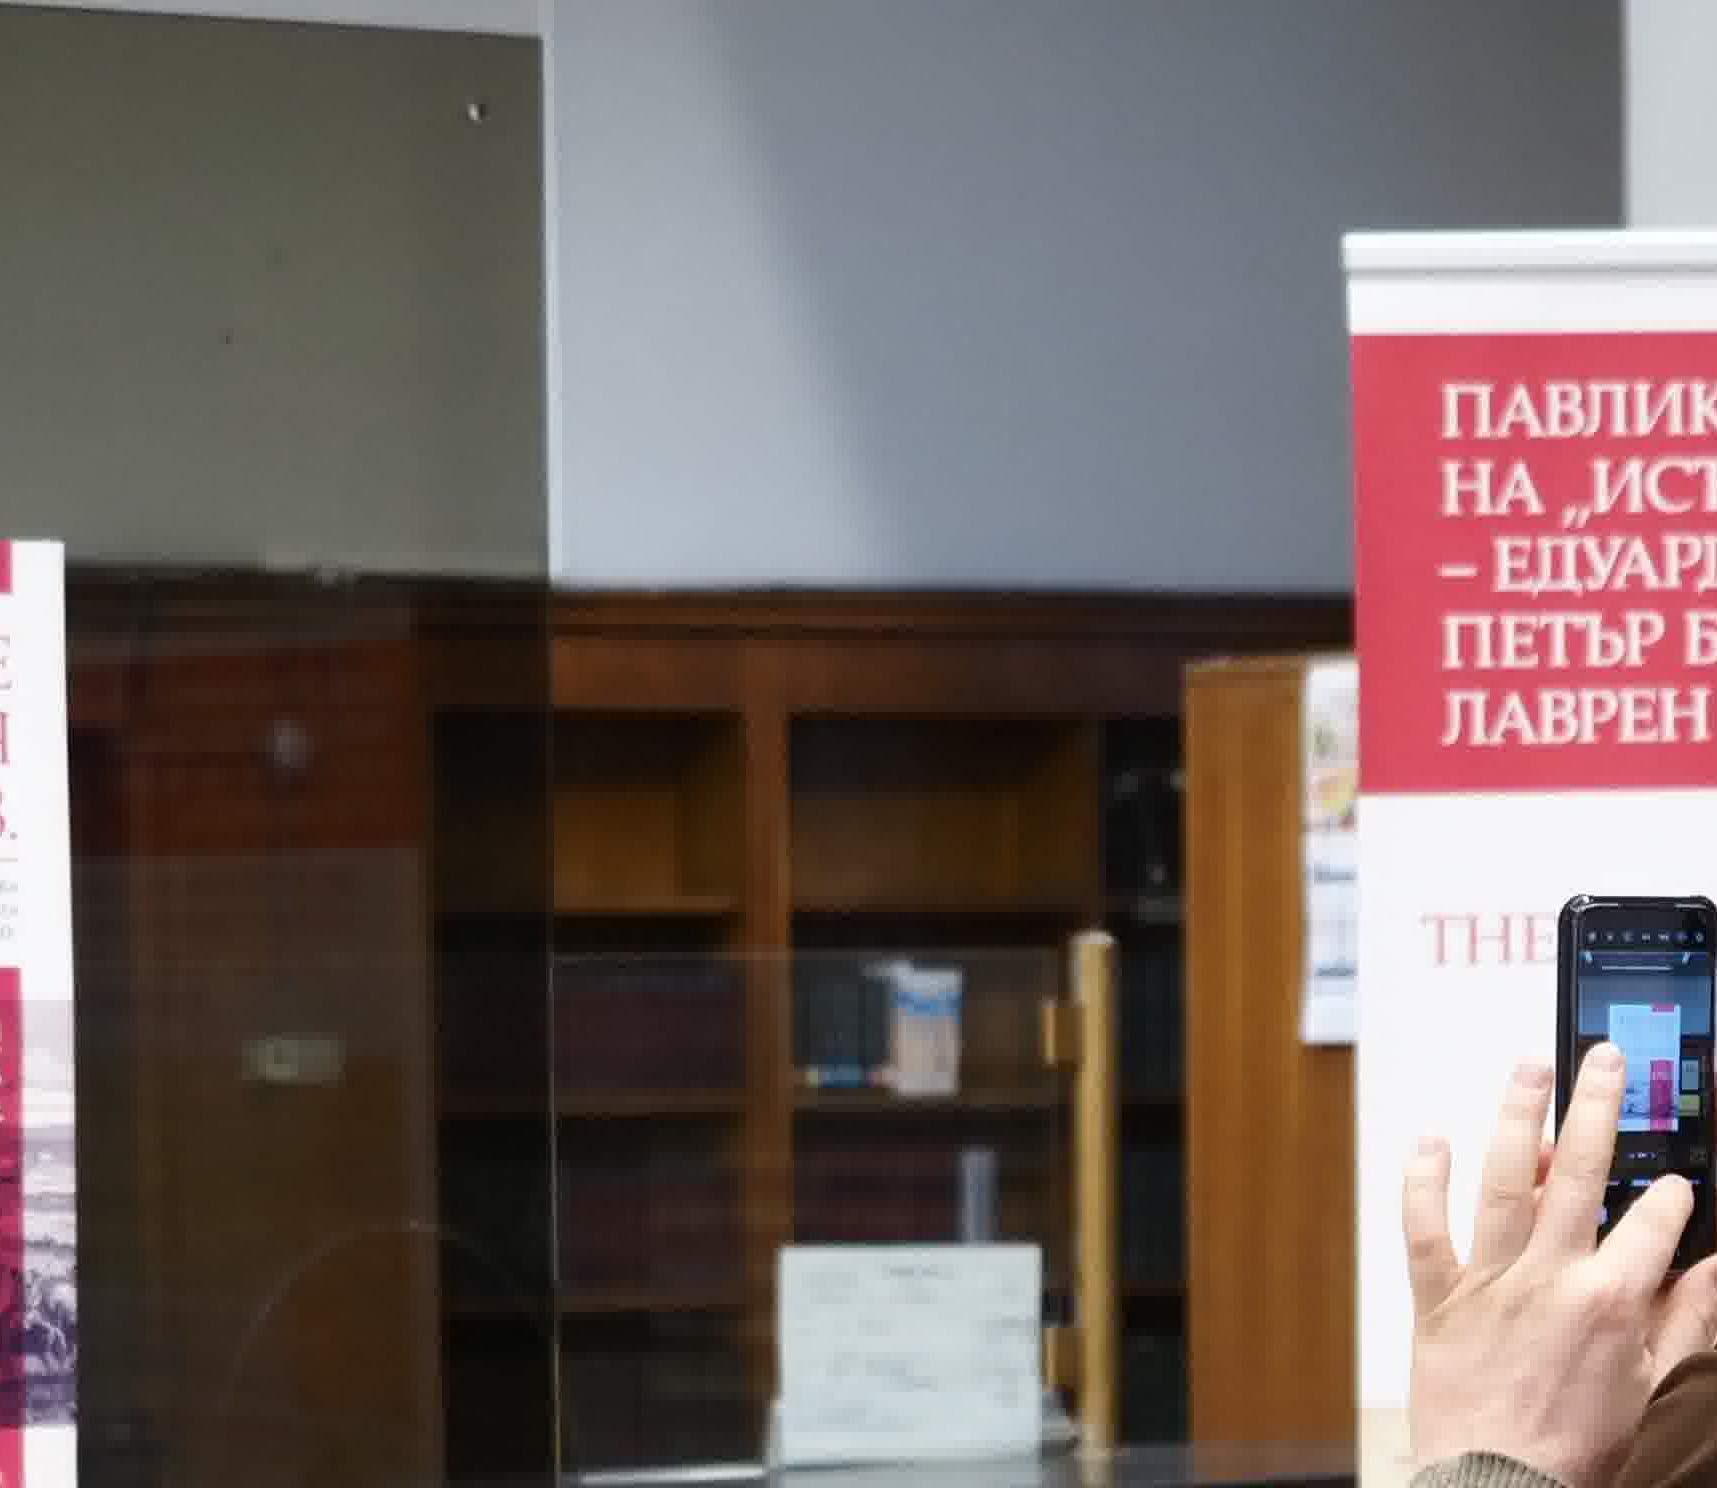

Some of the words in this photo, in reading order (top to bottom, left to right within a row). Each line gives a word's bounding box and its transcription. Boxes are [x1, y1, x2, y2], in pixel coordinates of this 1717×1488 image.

[1440, 459, 1545, 518] НА
[1440, 610, 1666, 670] ПЕТЪР
[1440, 689, 1713, 747] ЛАВРЕН
[1417, 911, 1556, 967] THE
